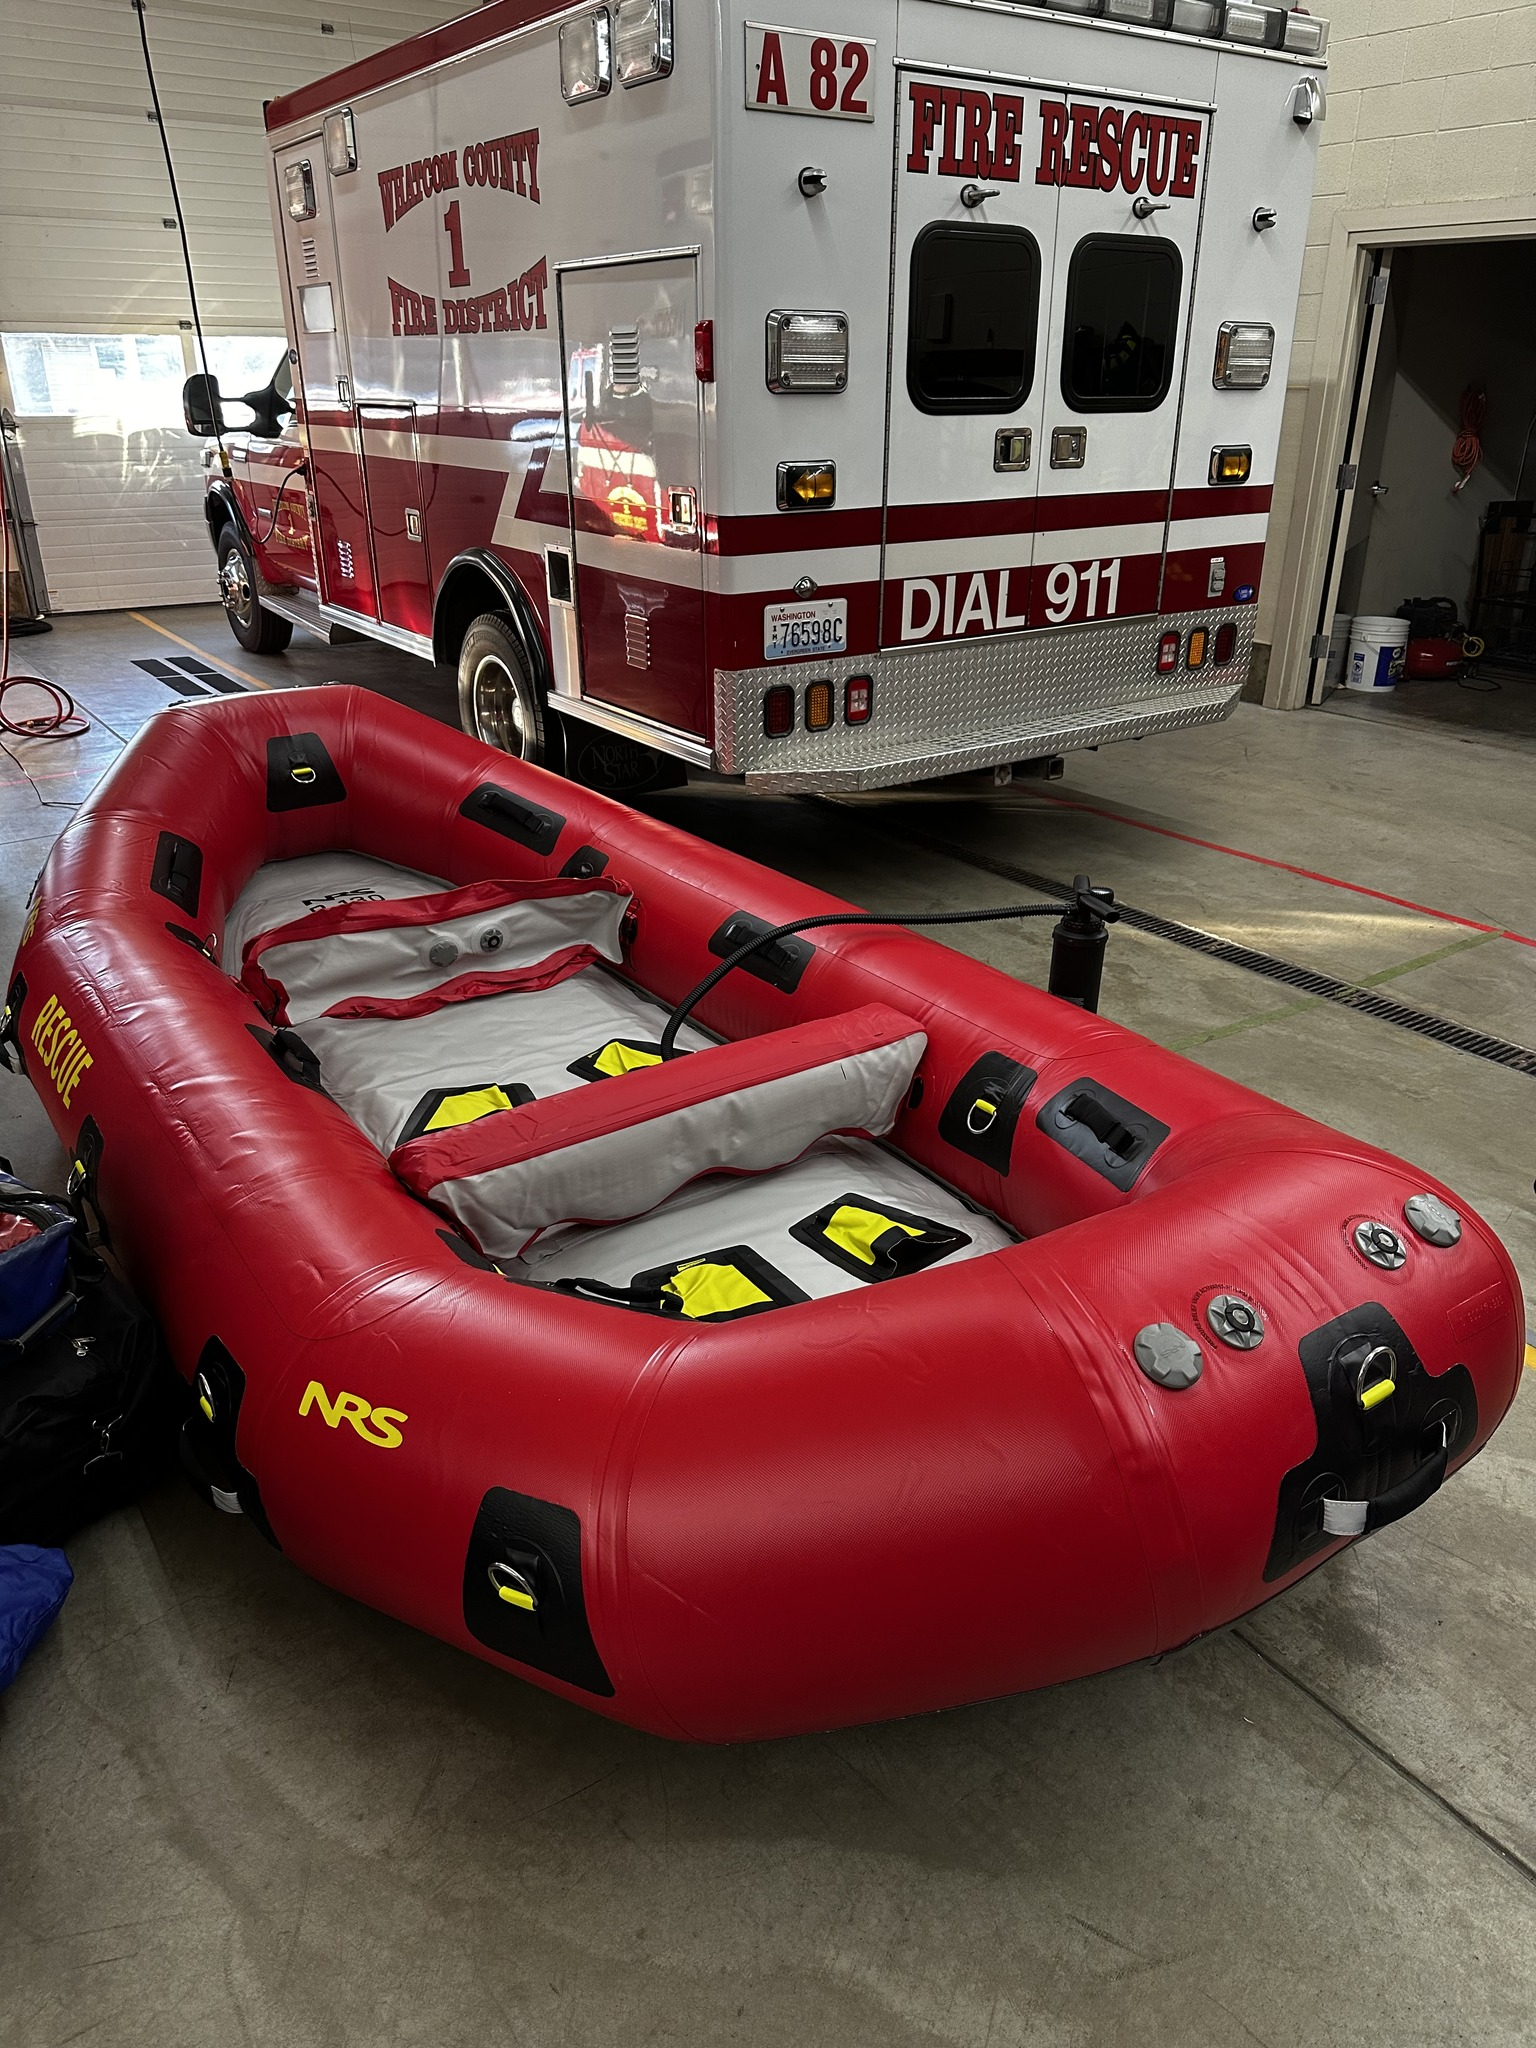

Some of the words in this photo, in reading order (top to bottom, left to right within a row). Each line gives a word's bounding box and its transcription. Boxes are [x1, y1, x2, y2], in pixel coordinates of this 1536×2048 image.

[756, 32, 788, 106] A
[810, 38, 869, 113] 82
[378, 150, 459, 233] WHATCOM
[463, 128, 540, 204] COUNTY
[907, 81, 1024, 182] FIRE
[1035, 99, 1203, 199] RESCUE
[444, 200, 470, 288] 1
[388, 276, 438, 336] FIRE
[442, 255, 548, 334] DISTRICT
[771, 611, 816, 622] WASHINGTON
[780, 617, 843, 649] 76598C
[900, 571, 1025, 641] DIAL
[1045, 558, 1121, 623] 911
[591, 743, 638, 770] NORTH
[604, 760, 640, 785] STAR
[31, 994, 94, 1110] RESCUE
[1194, 1322, 1218, 1350] PRESSURE
[299, 1380, 408, 1448] NRS
